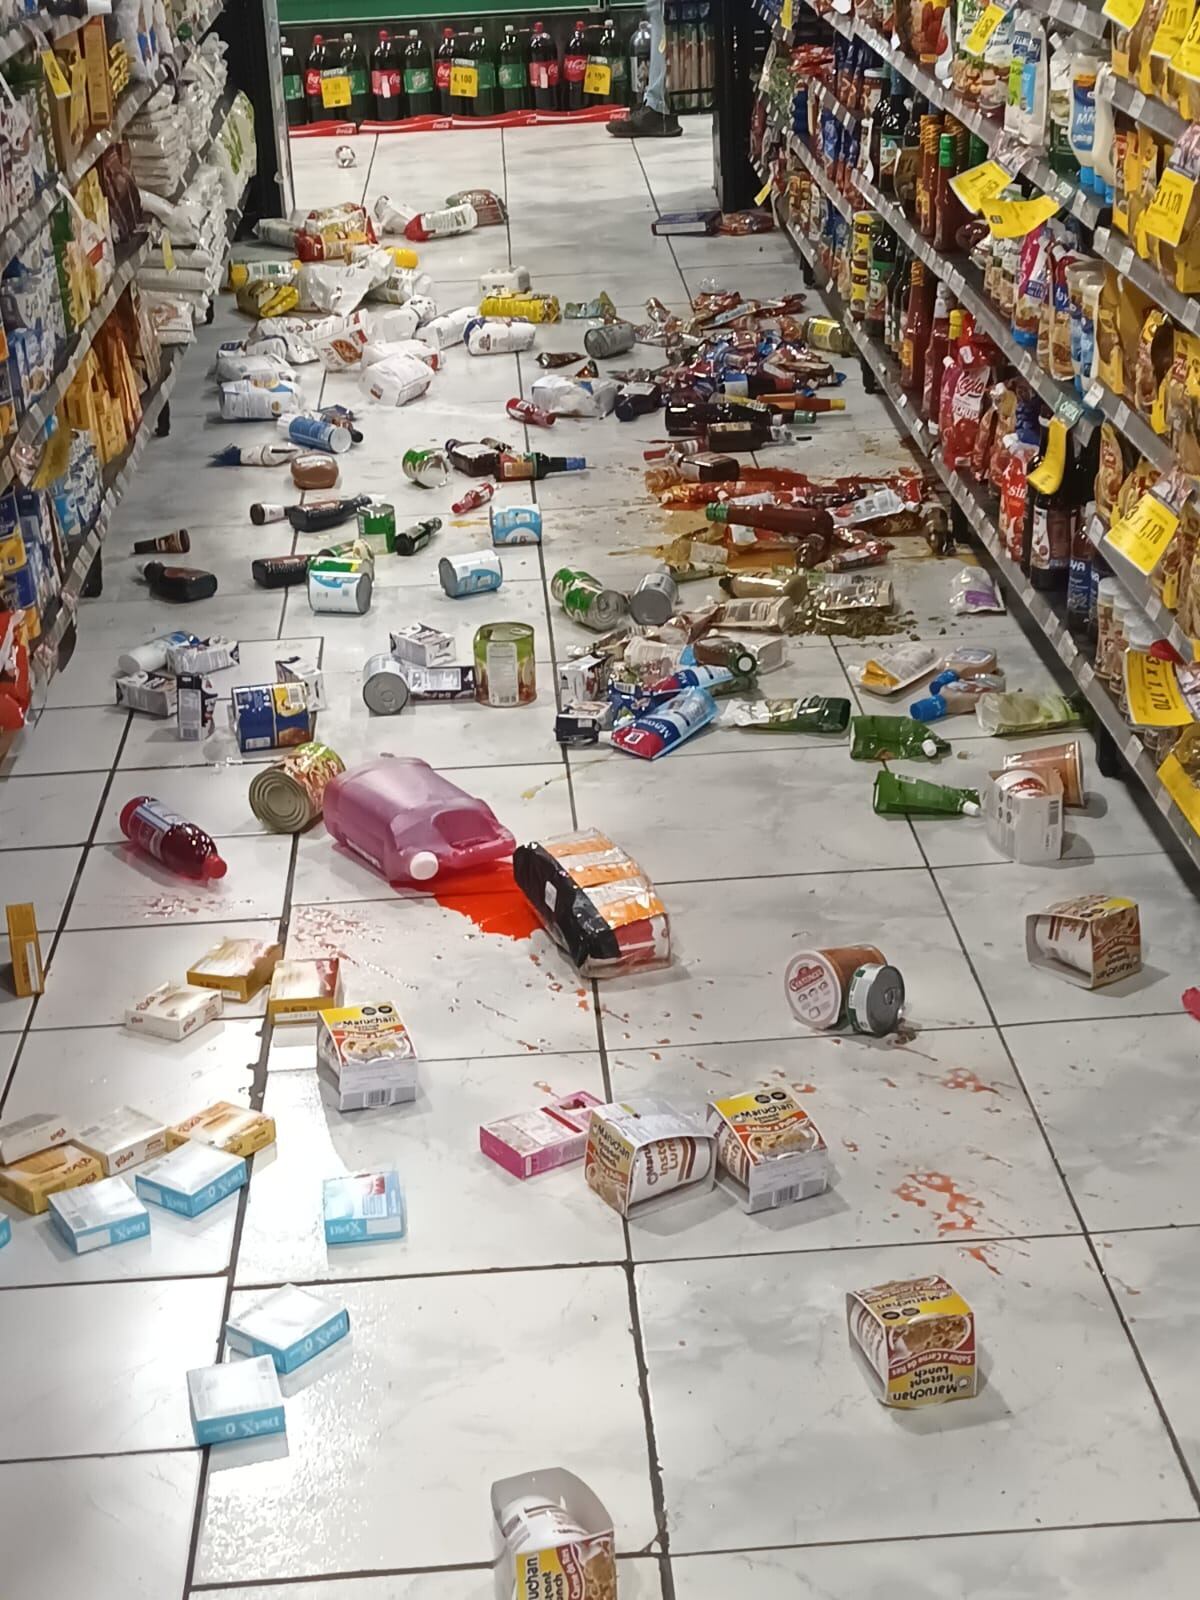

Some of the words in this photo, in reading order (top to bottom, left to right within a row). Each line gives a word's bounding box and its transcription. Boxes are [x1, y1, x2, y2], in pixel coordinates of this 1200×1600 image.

[342, 1016, 396, 1026] Maruchan
[740, 1102, 794, 1119] Maruchan
[918, 1351, 942, 1363] Carne
[948, 1353, 971, 1364] Sabor
[914, 1365, 949, 1377] Lunch
[910, 1374, 953, 1388] Instant
[893, 1383, 958, 1400] Maruchan
